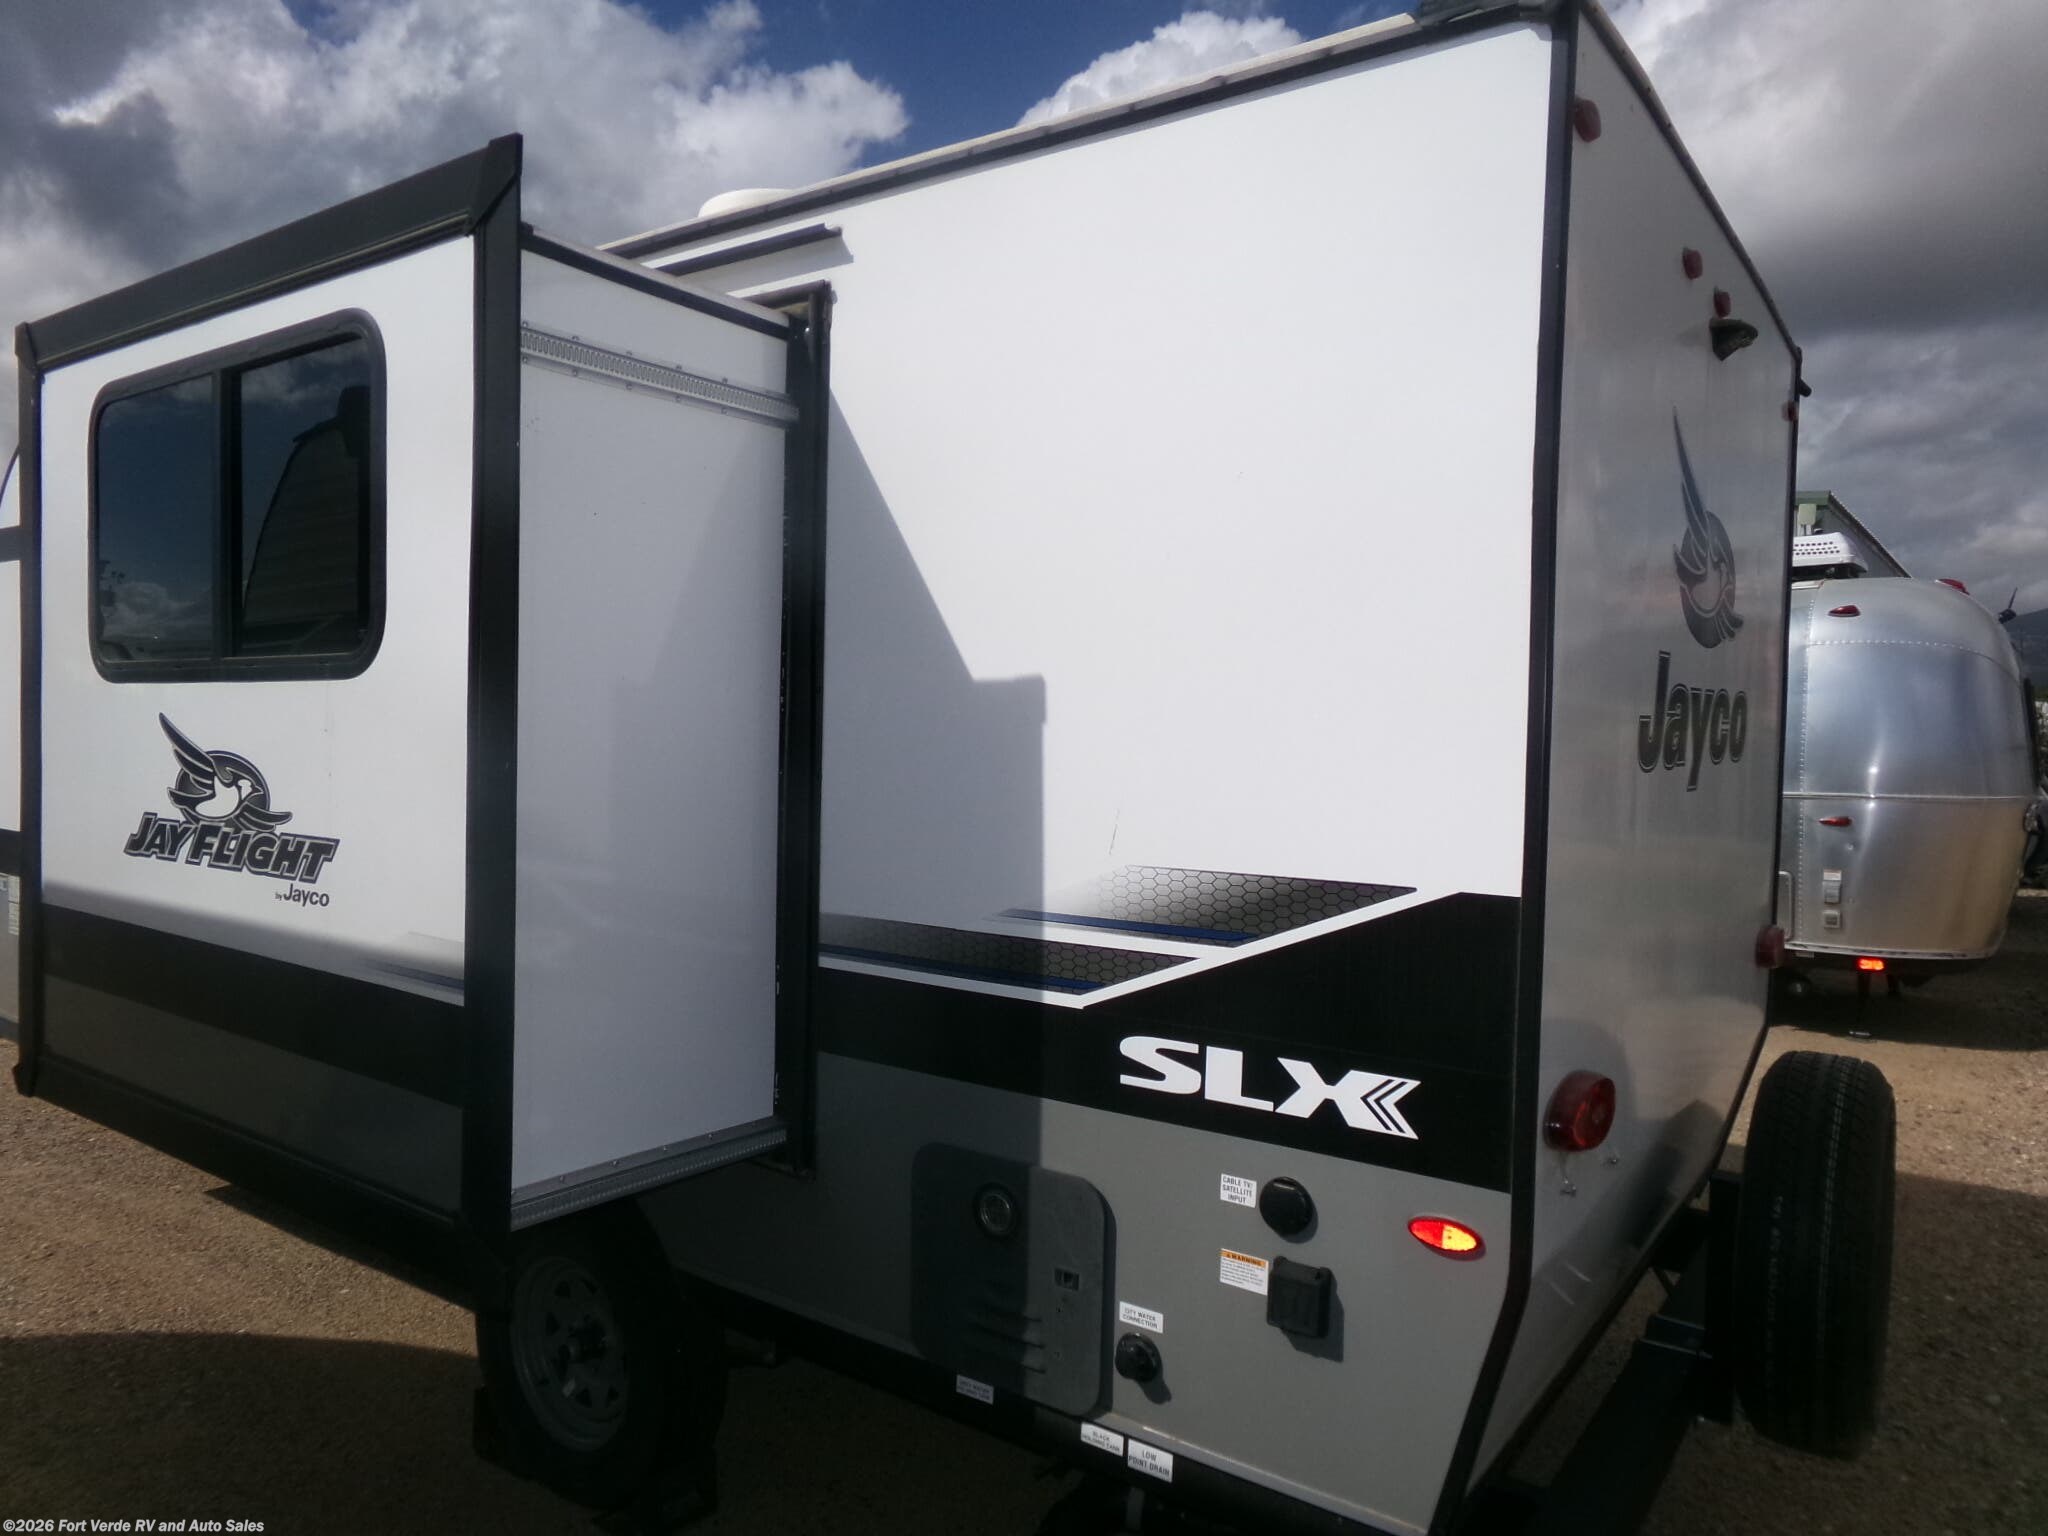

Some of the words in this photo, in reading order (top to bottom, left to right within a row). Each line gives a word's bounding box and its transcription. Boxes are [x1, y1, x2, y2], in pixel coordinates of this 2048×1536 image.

[1638, 650, 1748, 792] Jayco
[124, 812, 193, 862] JAY
[185, 821, 340, 884] FLIGHT
[284, 883, 330, 907] Jayco
[1119, 1036, 1421, 1140] SLX
[1222, 1175, 1242, 1188] CABLE
[1222, 1184, 1253, 1198] SATELLITE
[1228, 1193, 1247, 1204] INPUT
[1231, 1253, 1262, 1266] WARNING
[1122, 1314, 1158, 1329] CONNECTION
[1138, 1311, 1156, 1321] WATER
[1142, 1450, 1157, 1461] LOW
[1129, 1455, 1147, 1469] POINT
[1149, 1462, 1170, 1477] DRAIN
